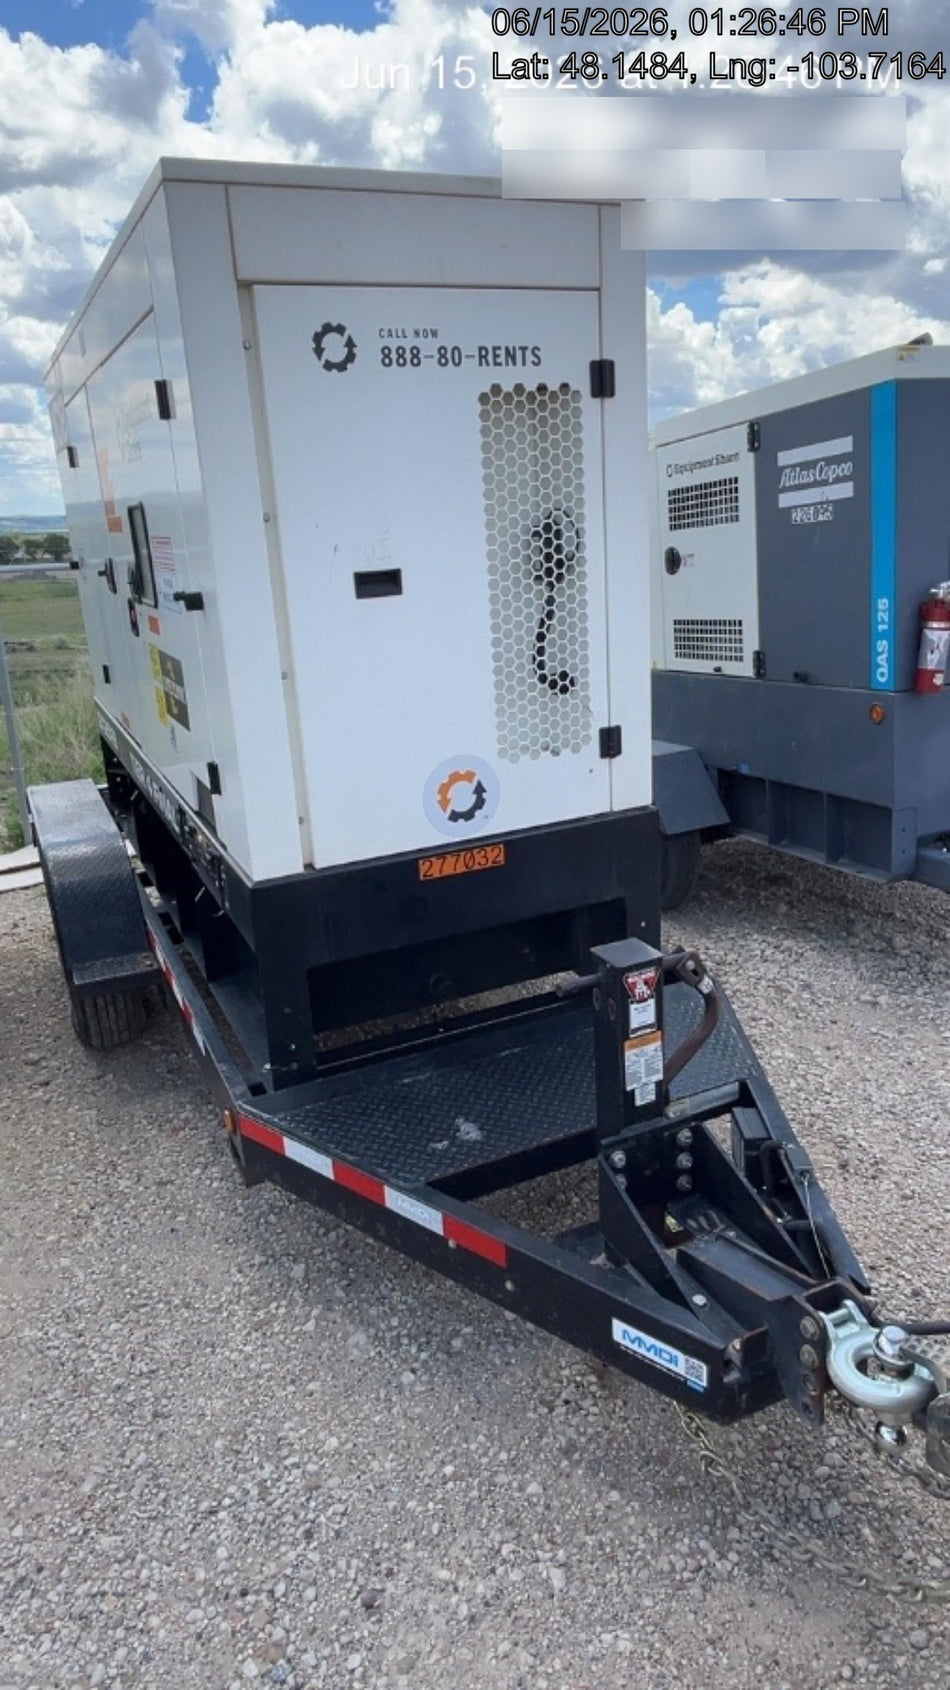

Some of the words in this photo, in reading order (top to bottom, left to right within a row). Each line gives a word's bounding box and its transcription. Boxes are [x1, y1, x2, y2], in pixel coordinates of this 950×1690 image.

[379, 328, 408, 339] CALL
[414, 328, 439, 339] NOW
[380, 345, 542, 368] 888-80-RENTS
[877, 598, 889, 633] 125
[421, 847, 502, 877] 277032
